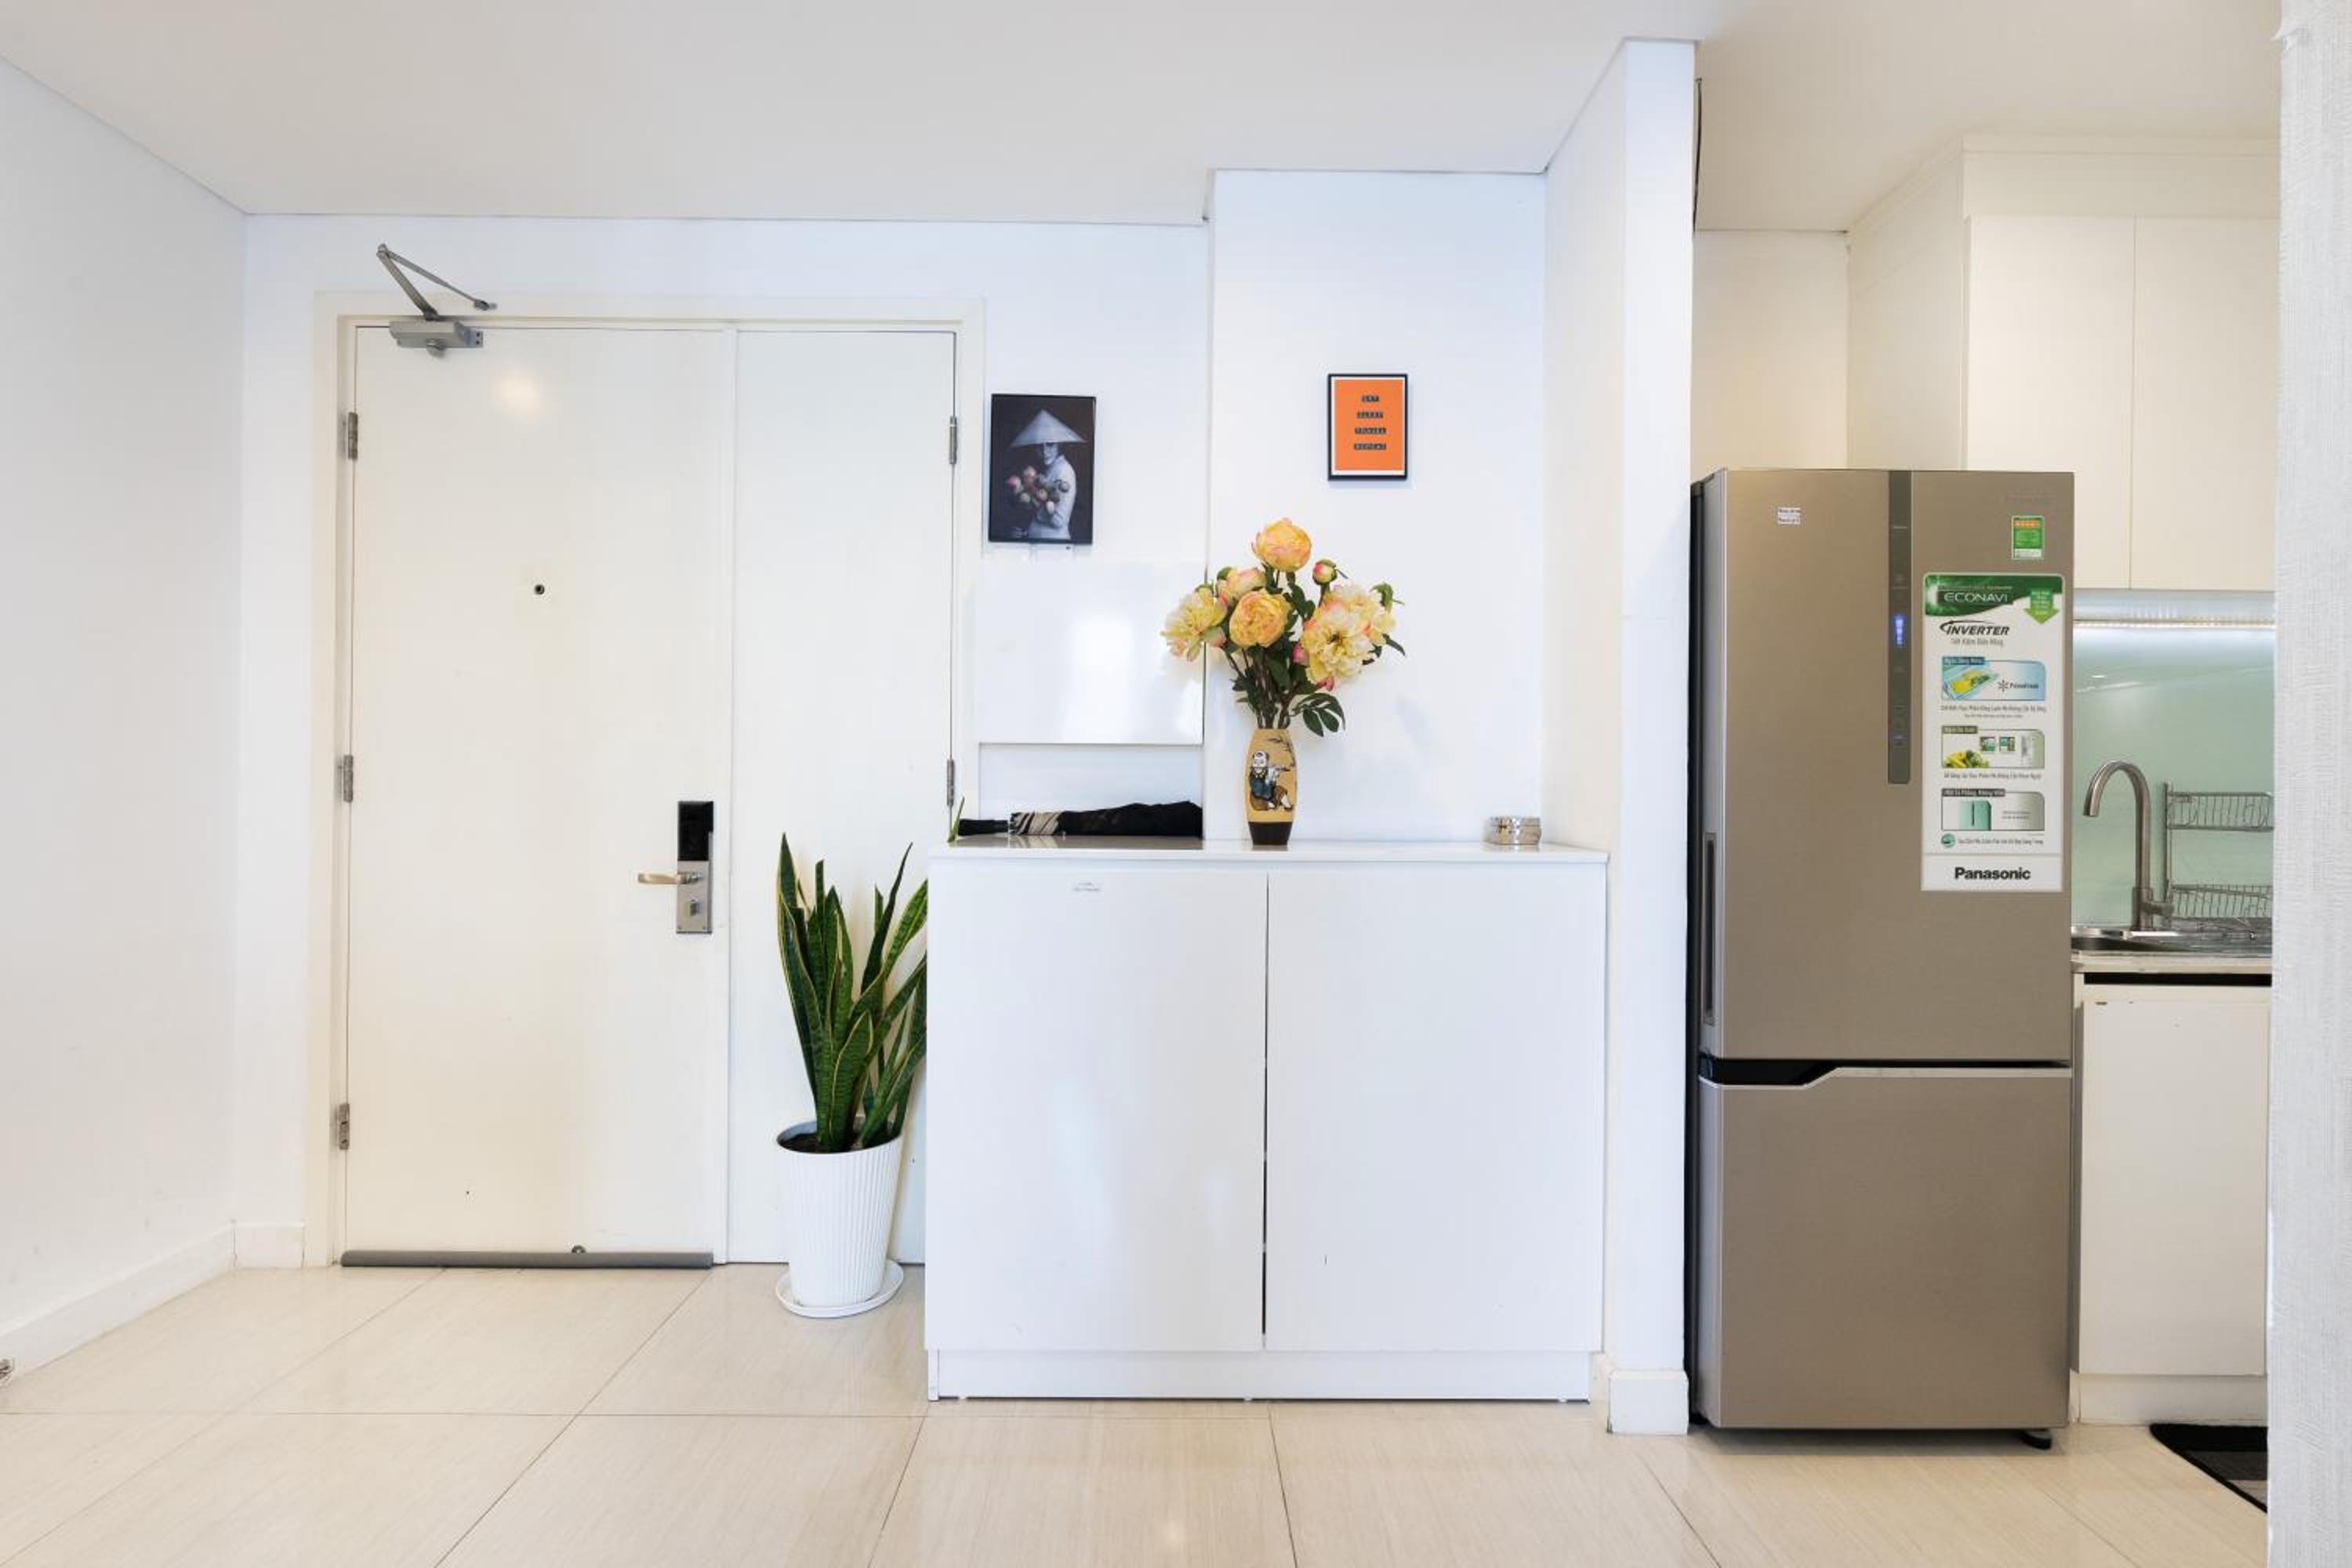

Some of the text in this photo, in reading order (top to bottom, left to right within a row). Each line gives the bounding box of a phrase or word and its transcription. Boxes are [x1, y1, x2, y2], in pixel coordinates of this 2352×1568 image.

[1944, 592, 2007, 603] ECONAVI
[1946, 626, 2009, 636] INVERTER
[1955, 866, 2031, 880] Panasonic
